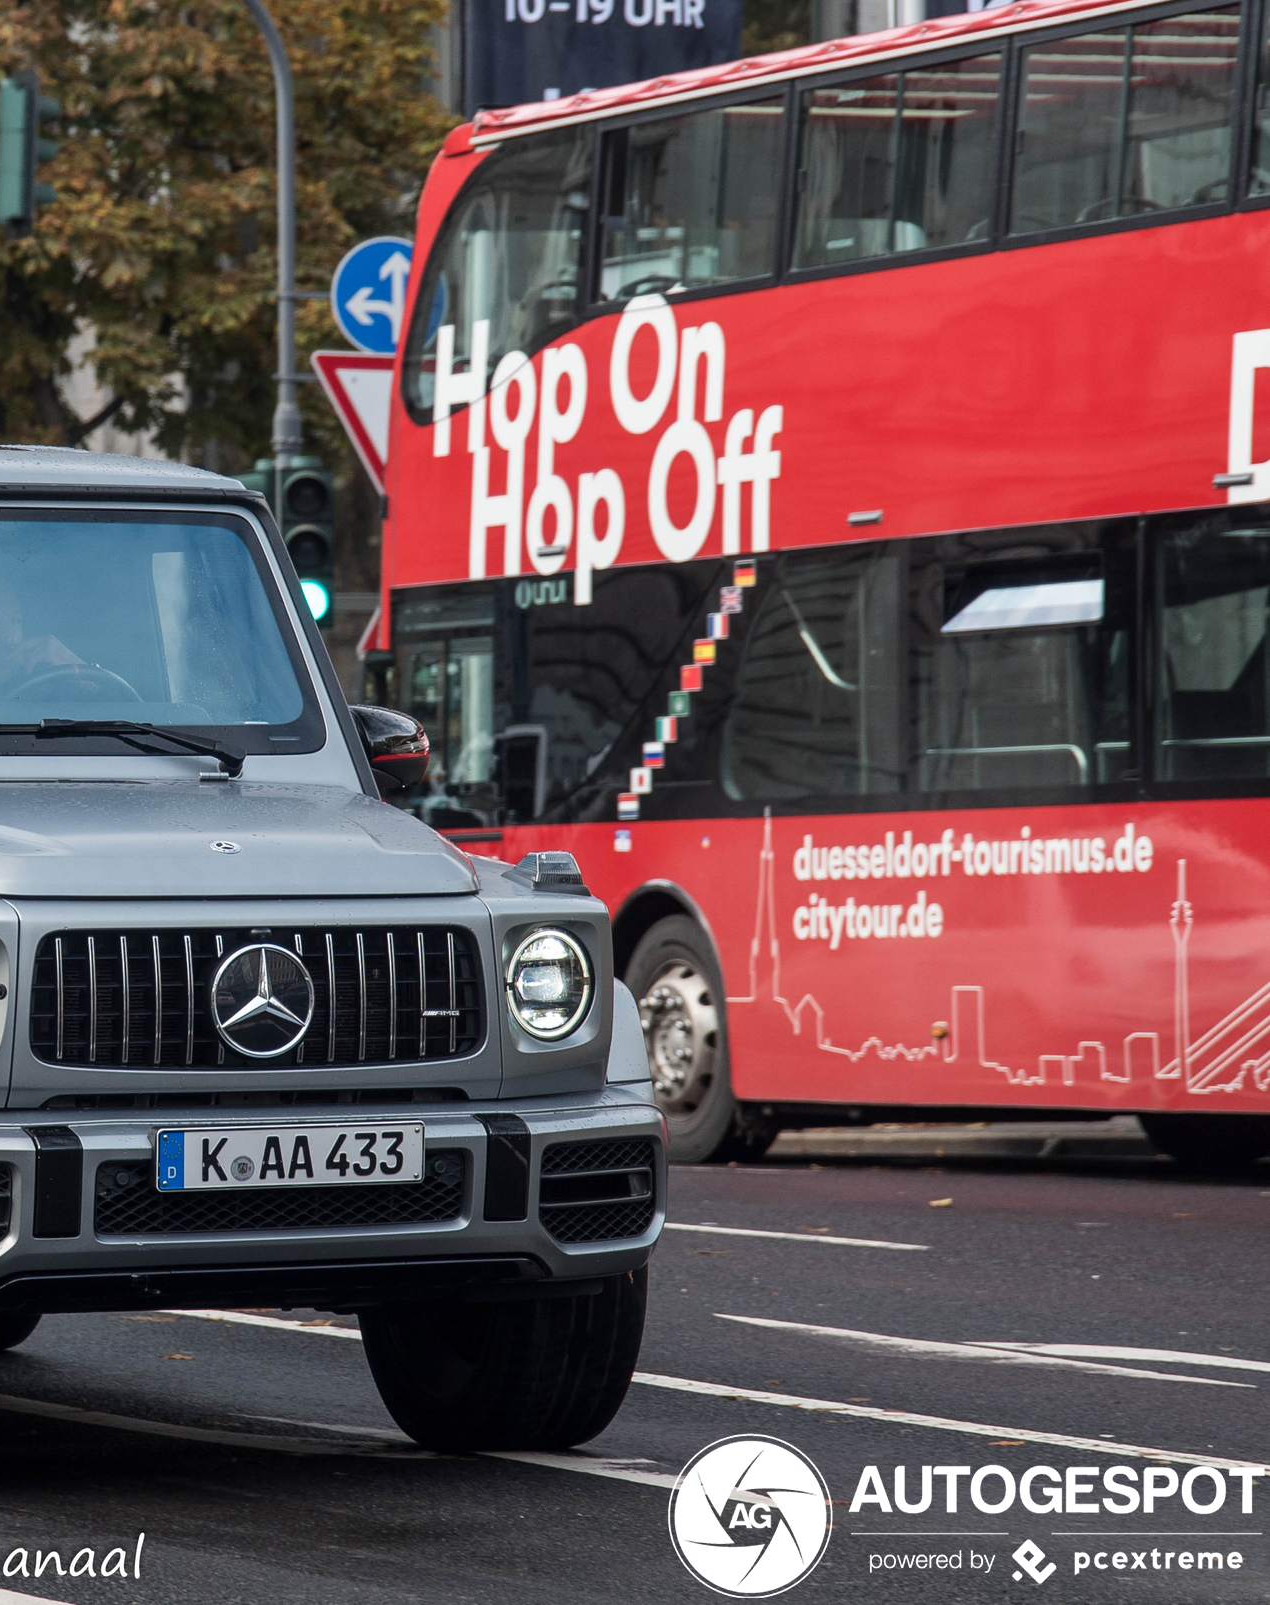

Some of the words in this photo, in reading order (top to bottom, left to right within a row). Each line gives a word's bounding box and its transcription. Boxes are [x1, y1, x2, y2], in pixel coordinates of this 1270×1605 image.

[624, 0, 706, 29] UHR
[433, 319, 587, 485] Hop
[610, 293, 725, 434] On
[469, 447, 625, 605] Hop
[648, 405, 783, 562] Off
[793, 822, 1154, 881] duesseldorf-tourismus.de
[793, 890, 944, 950] citytour.de
[167, 1166, 177, 1179] D
[201, 1137, 228, 1182] K
[259, 1135, 314, 1180] AA
[325, 1131, 404, 1177] 433
